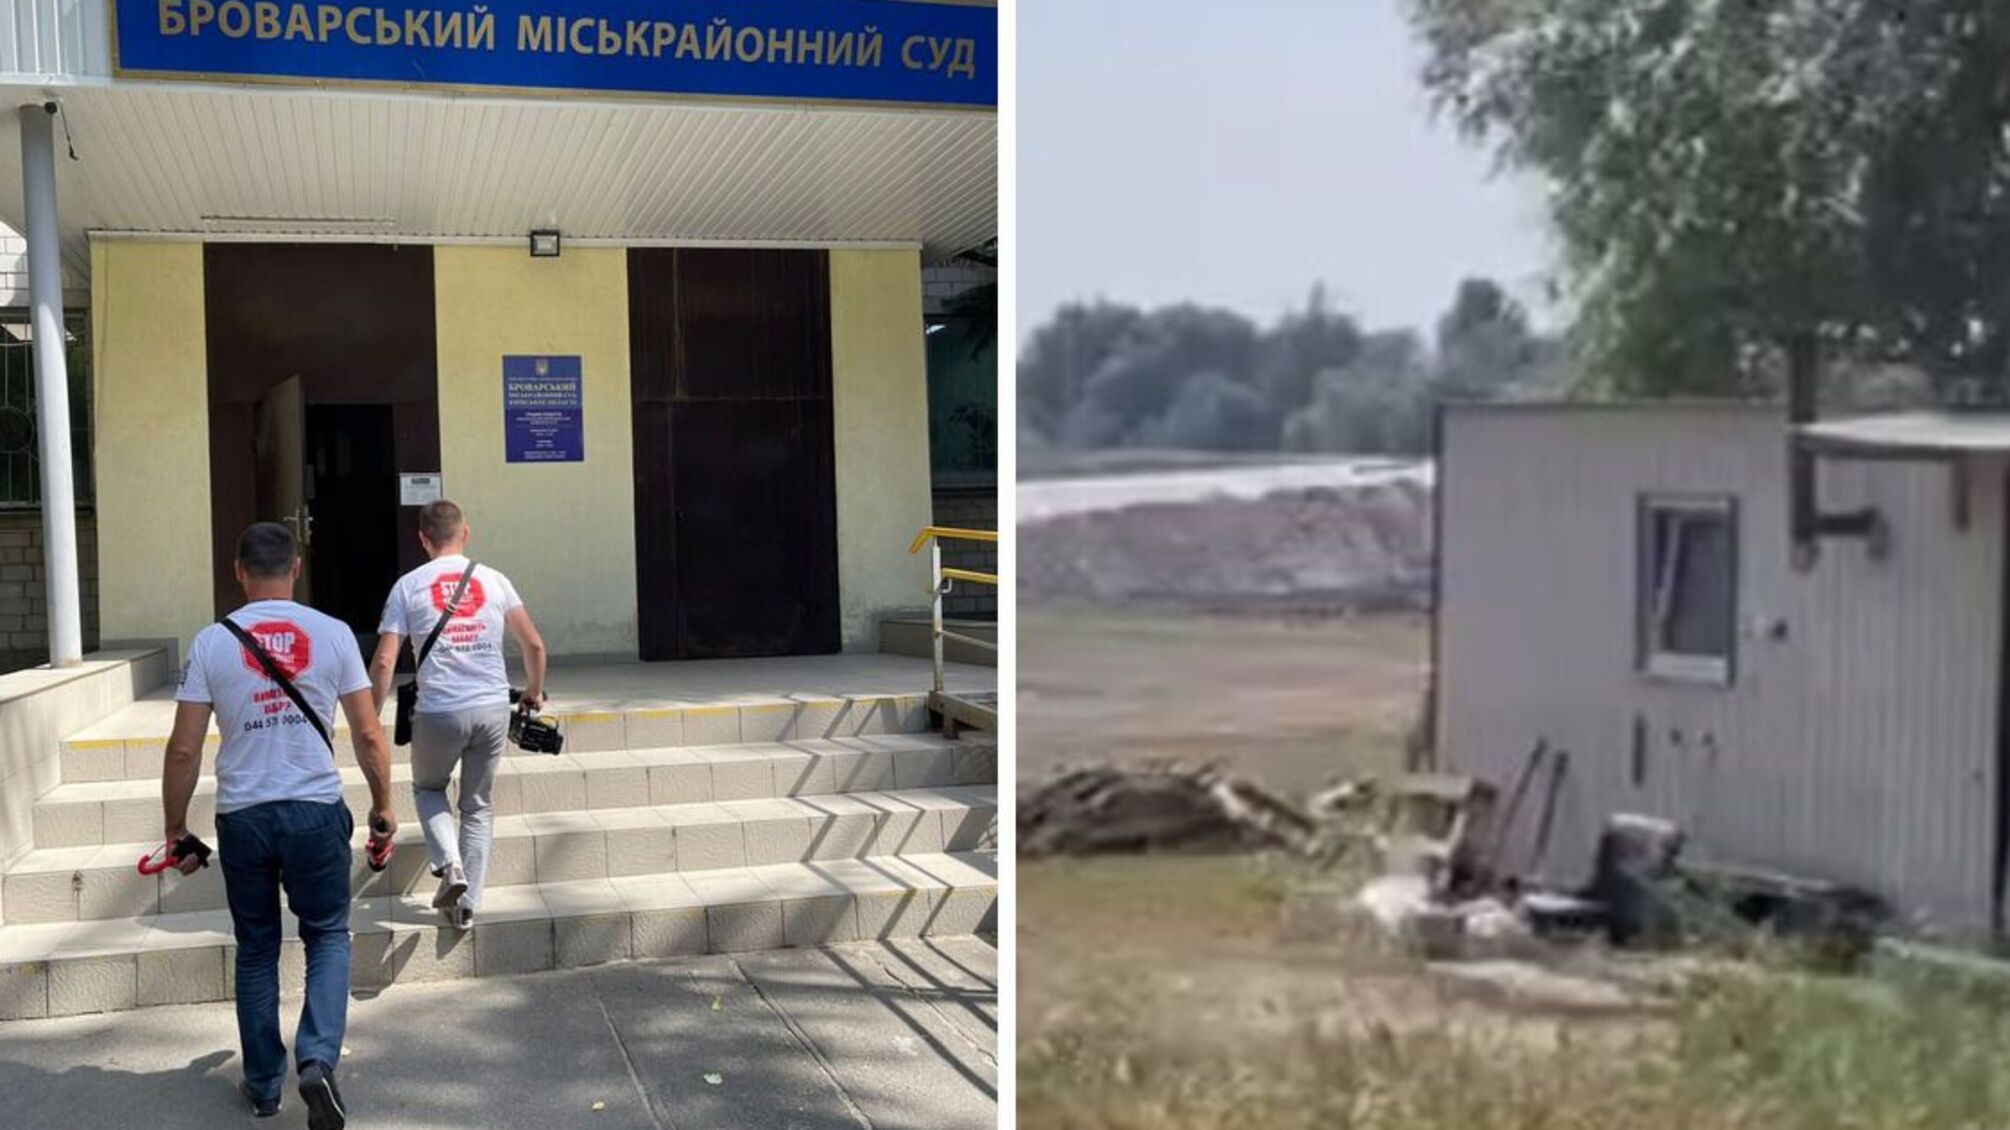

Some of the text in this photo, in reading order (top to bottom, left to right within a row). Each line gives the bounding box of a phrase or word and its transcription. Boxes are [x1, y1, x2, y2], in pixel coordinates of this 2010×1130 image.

[158, 0, 976, 80] БРОВАРСЬКИЙ МІСЬКРАЙОННИЙ СУД
[440, 581, 473, 596] STP
